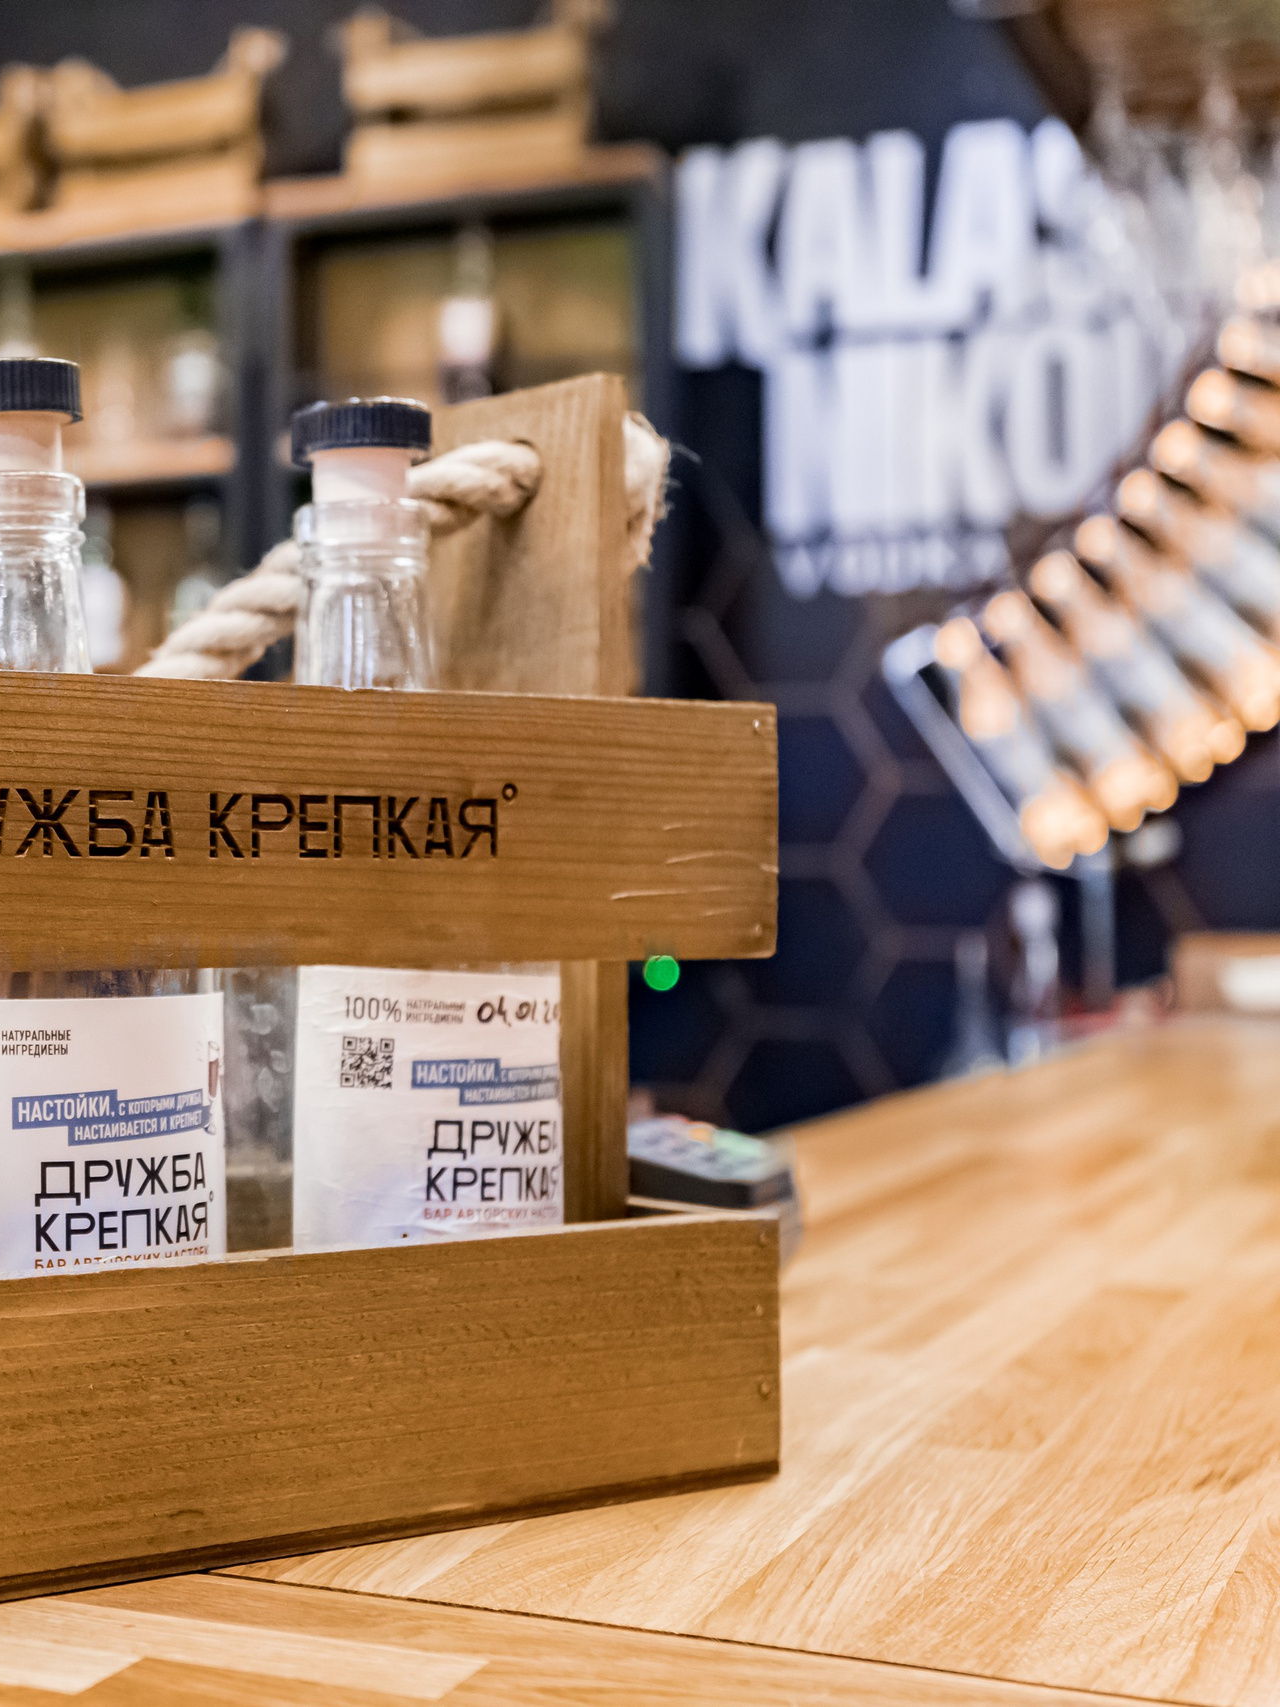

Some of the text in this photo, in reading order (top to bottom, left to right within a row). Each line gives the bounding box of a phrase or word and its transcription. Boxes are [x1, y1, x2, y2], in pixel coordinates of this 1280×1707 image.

[345, 996, 402, 1023] 100%
[1, 1029, 72, 1042] НАТУРАЛЬНЫЕ
[1, 1043, 69, 1059] ИНГРЕДИЕНЫ
[17, 1093, 115, 1123] НАСТОЙКИ,
[128, 1096, 176, 1116] КОТОРЫМИ
[74, 1109, 202, 1142] НАСТАИВАЕТСЯ И КРЕПНЕТ
[34, 1151, 207, 1207] ДРУЖБА
[423, 1208, 453, 1220] БАР
